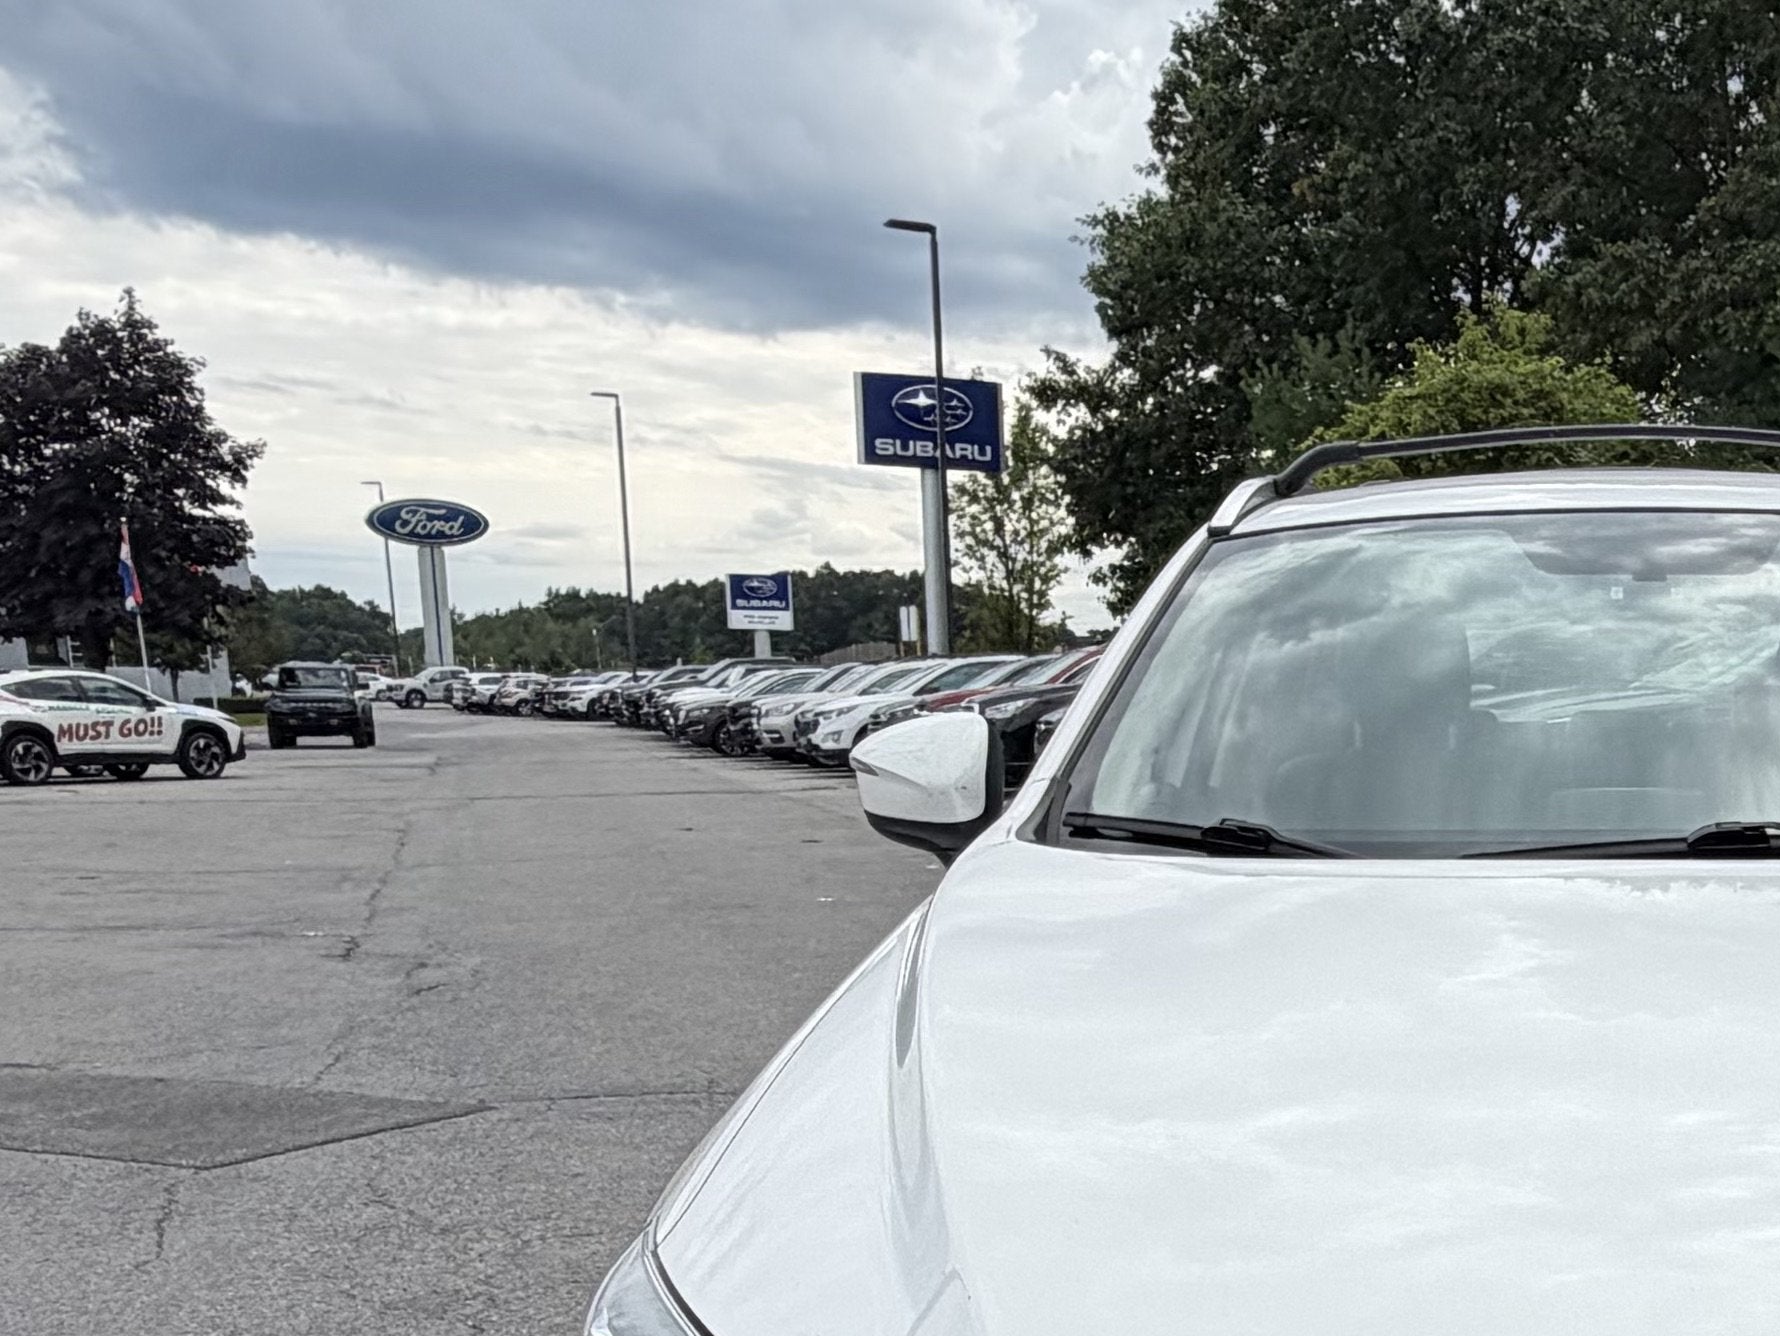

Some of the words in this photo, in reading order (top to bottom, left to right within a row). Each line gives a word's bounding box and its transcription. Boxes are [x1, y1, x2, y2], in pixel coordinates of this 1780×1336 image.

[874, 438, 992, 461] SUBARU
[395, 506, 464, 535] Ford
[57, 720, 114, 743] MUST
[118, 716, 163, 739] GO!!
